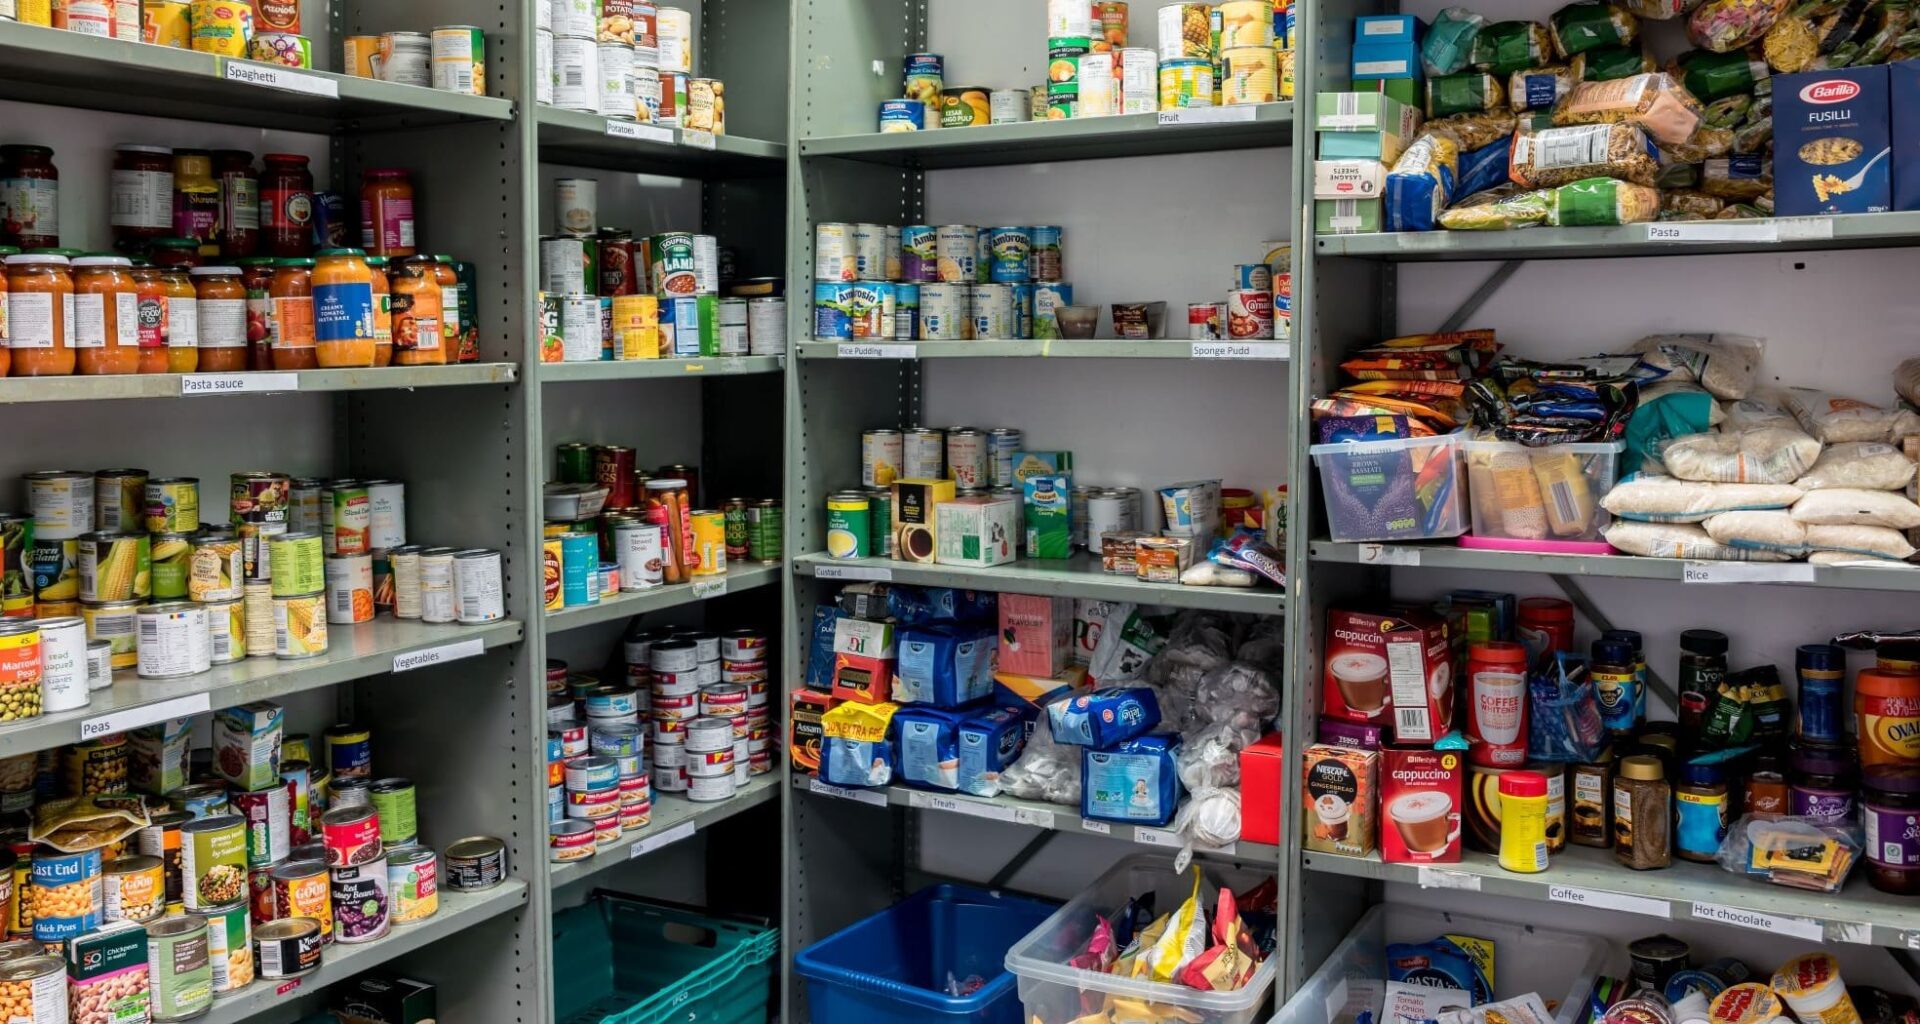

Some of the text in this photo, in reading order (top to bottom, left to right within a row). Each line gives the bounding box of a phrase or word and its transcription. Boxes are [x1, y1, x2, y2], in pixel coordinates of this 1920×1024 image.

[229, 65, 277, 83] Spaghetti
[1813, 84, 1855, 98] Barilla
[1160, 114, 1179, 122] Fruit
[1809, 109, 1851, 122] FUSILLI
[608, 123, 635, 135] Potatoes
[1651, 228, 1680, 238] Pasta
[1038, 300, 1054, 308] Rice
[140, 309, 160, 317] FOOD
[839, 347, 882, 356] Rice Pudding
[1194, 346, 1250, 356] Sponge Pudd
[184, 378, 244, 390] Pasta sauce
[816, 568, 842, 577] Custard
[1686, 570, 1709, 580] Rice
[394, 651, 440, 668] Vegetables
[16, 669, 37, 679] Peas
[1480, 694, 1519, 707] COFFEE
[1481, 704, 1518, 713] WHITENER
[83, 721, 110, 735] Peas
[842, 722, 867, 736] EXTRA
[1414, 756, 1454, 766] lifestyle £1
[1321, 773, 1344, 782] GOLD
[1392, 769, 1451, 781] cappuccino
[810, 782, 856, 798] Speciality Tea
[1311, 781, 1354, 793] GINGERBREAD
[933, 798, 956, 809] Treats
[1141, 832, 1156, 842] Tea
[32, 861, 79, 876] East End
[125, 877, 153, 888] GOOD
[295, 883, 327, 899] GOOD
[343, 884, 358, 893] Red
[352, 888, 375, 899] Beans
[420, 884, 436, 894] CORN
[1550, 887, 1585, 902] Coffee
[1694, 903, 1772, 928] Hot chocolate
[36, 923, 77, 933] Chick Peas
[106, 943, 138, 956] Chickpeas
[83, 953, 102, 965] SO
[1406, 976, 1444, 989] PASTA
[1396, 996, 1424, 1006] Tomato
